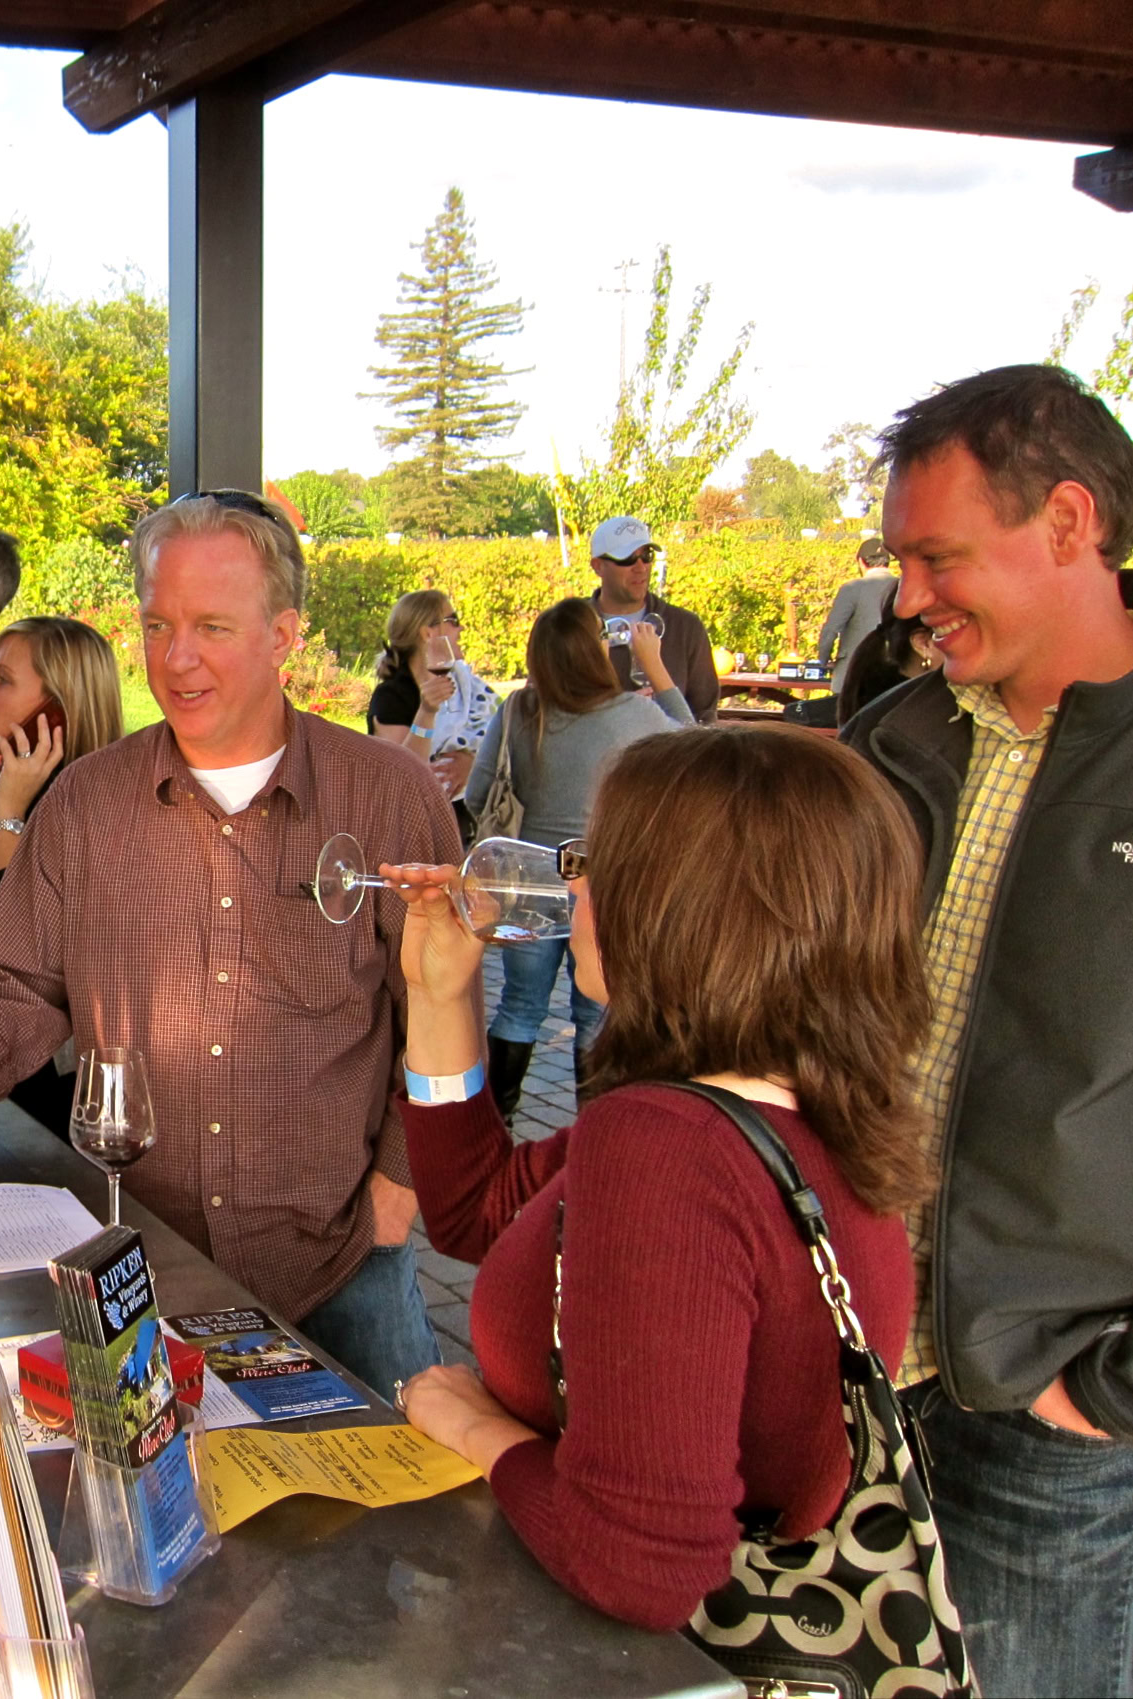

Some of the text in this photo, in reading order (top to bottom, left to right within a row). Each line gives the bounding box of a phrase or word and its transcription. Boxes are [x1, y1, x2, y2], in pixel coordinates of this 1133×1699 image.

[99, 1246, 144, 1299] RIPKEN
[118, 1272, 147, 1303] Vineyards
[122, 1288, 148, 1318] & Winery
[177, 1311, 258, 1326] RIPKEN
[209, 1318, 264, 1328] Vineyards
[226, 1323, 264, 1331] Winery
[236, 1357, 311, 1379] Wine Club
[139, 1433, 160, 1462] Wine
[159, 1409, 175, 1443] Club
[258, 1455, 287, 1478] SALE
[338, 1465, 365, 1491] SALE
